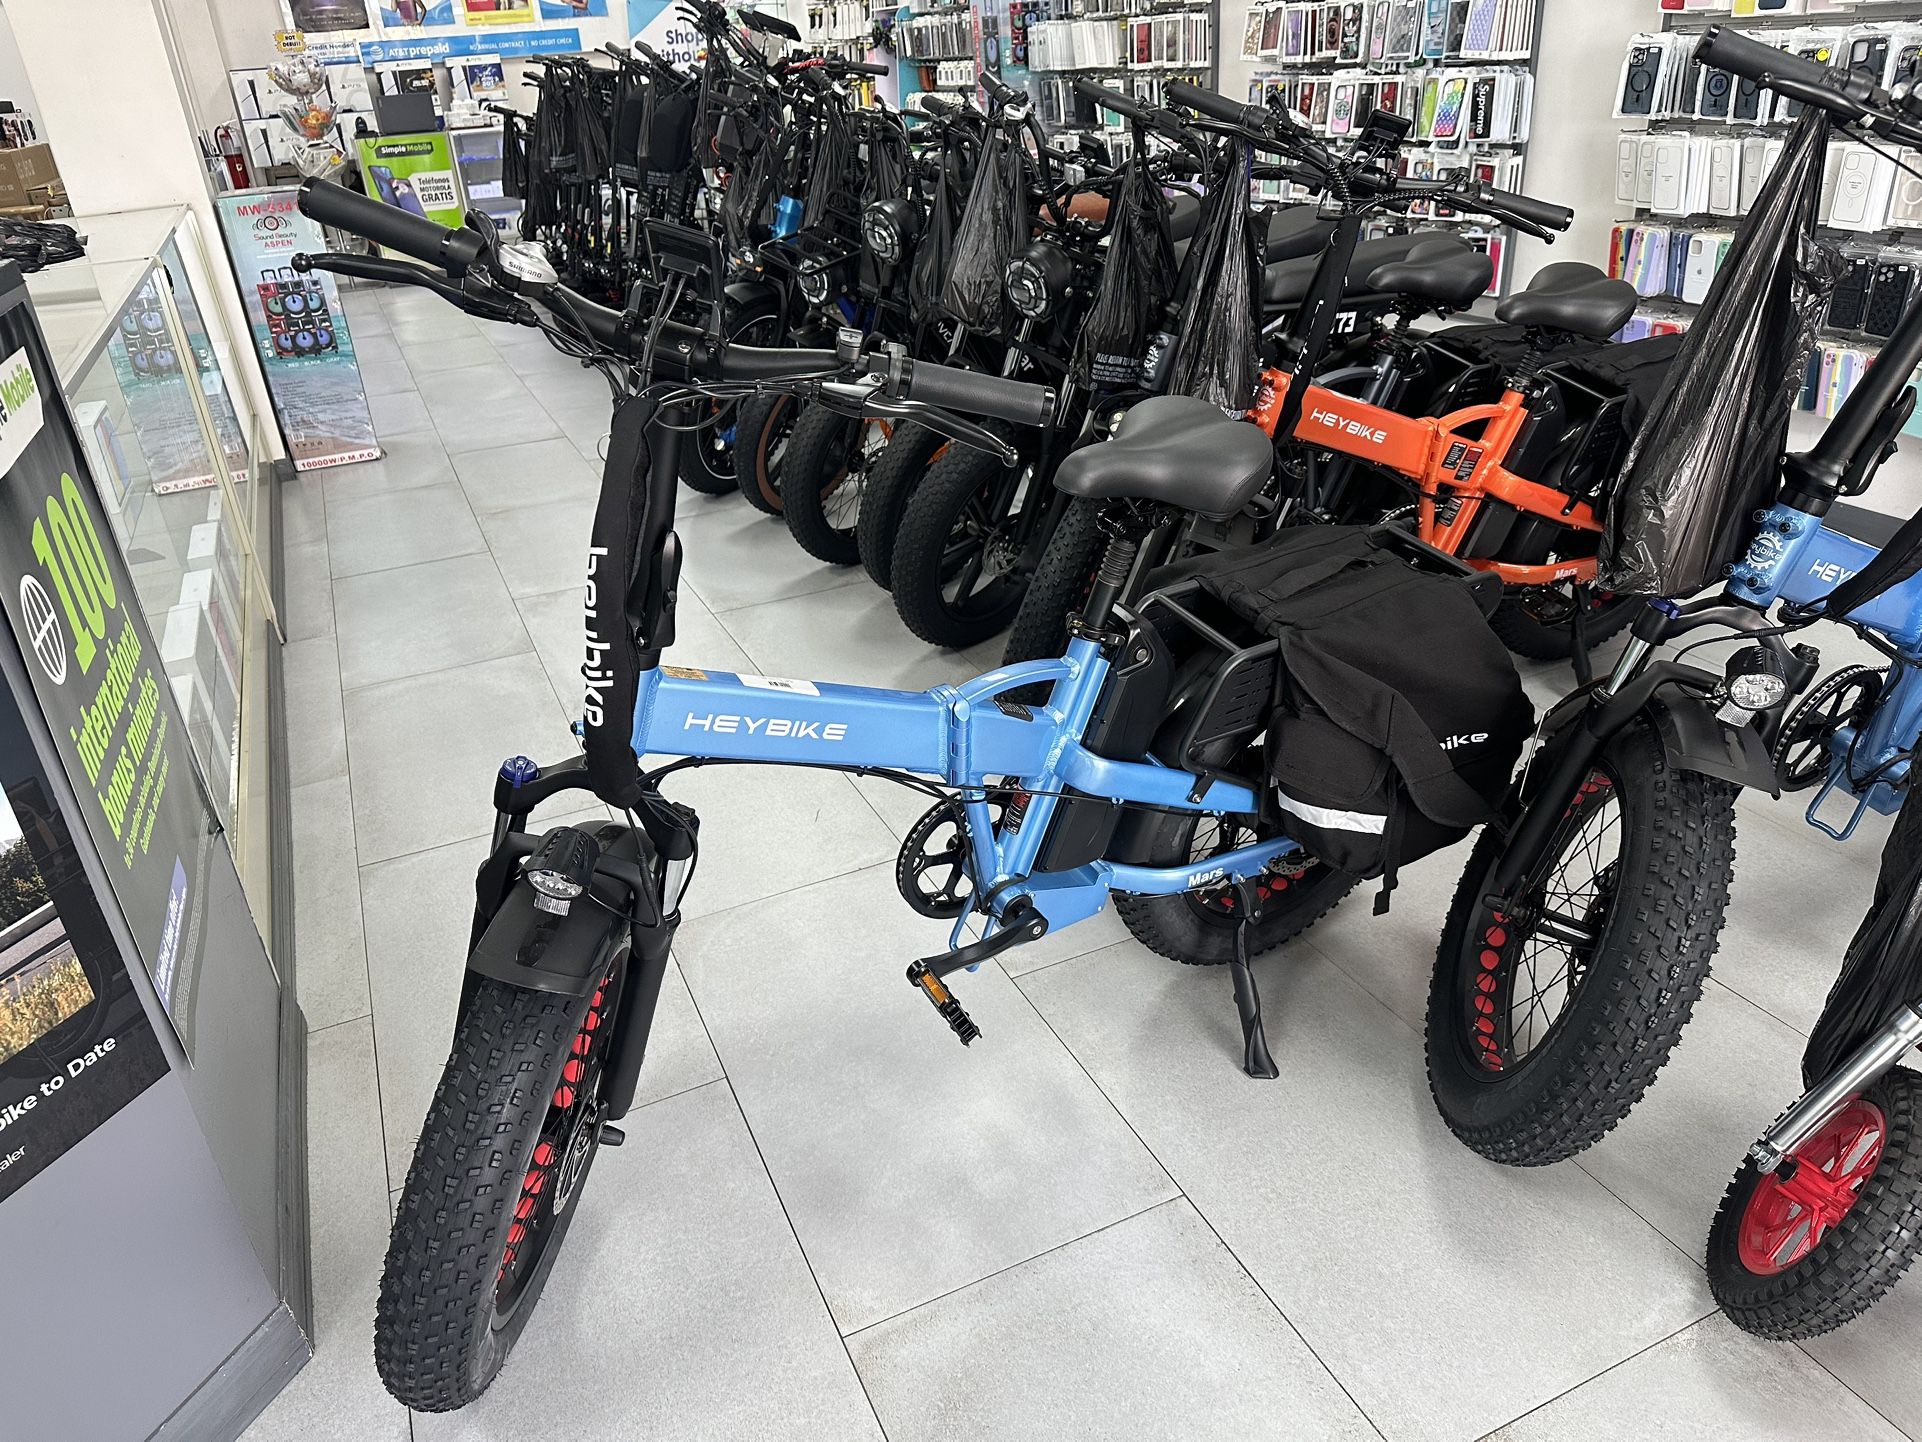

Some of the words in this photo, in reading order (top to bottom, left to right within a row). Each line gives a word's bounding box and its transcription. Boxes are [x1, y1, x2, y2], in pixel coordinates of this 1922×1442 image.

[307, 43, 328, 51] Credit
[498, 40, 525, 49] CONTRACT
[540, 38, 556, 46] CREDIT
[557, 37, 573, 45] CHECK
[665, 30, 704, 46] Shop
[409, 42, 450, 58] prepaid
[1476, 84, 1490, 135] Supreme
[381, 143, 406, 154] Simple
[406, 142, 432, 152] Mobile
[418, 176, 450, 186] Teléfonos
[419, 185, 452, 193] MOTOROLA
[421, 192, 454, 204] GRATIS
[264, 240, 293, 249] ASPEN
[508, 261, 543, 279] SHIMANO
[1309, 407, 1388, 444] HEYBIKE
[32, 472, 117, 676] 100
[1554, 567, 1578, 580] Mars
[1808, 558, 1857, 585] HEY
[70, 601, 142, 788] international
[684, 712, 848, 741] HEYBIKE
[97, 745, 136, 842] bonus
[126, 668, 160, 768] minutes
[1188, 867, 1224, 887] Mars
[40, 1075, 65, 1097] to
[67, 1037, 116, 1078] Date
[0, 1145, 26, 1174] aler
